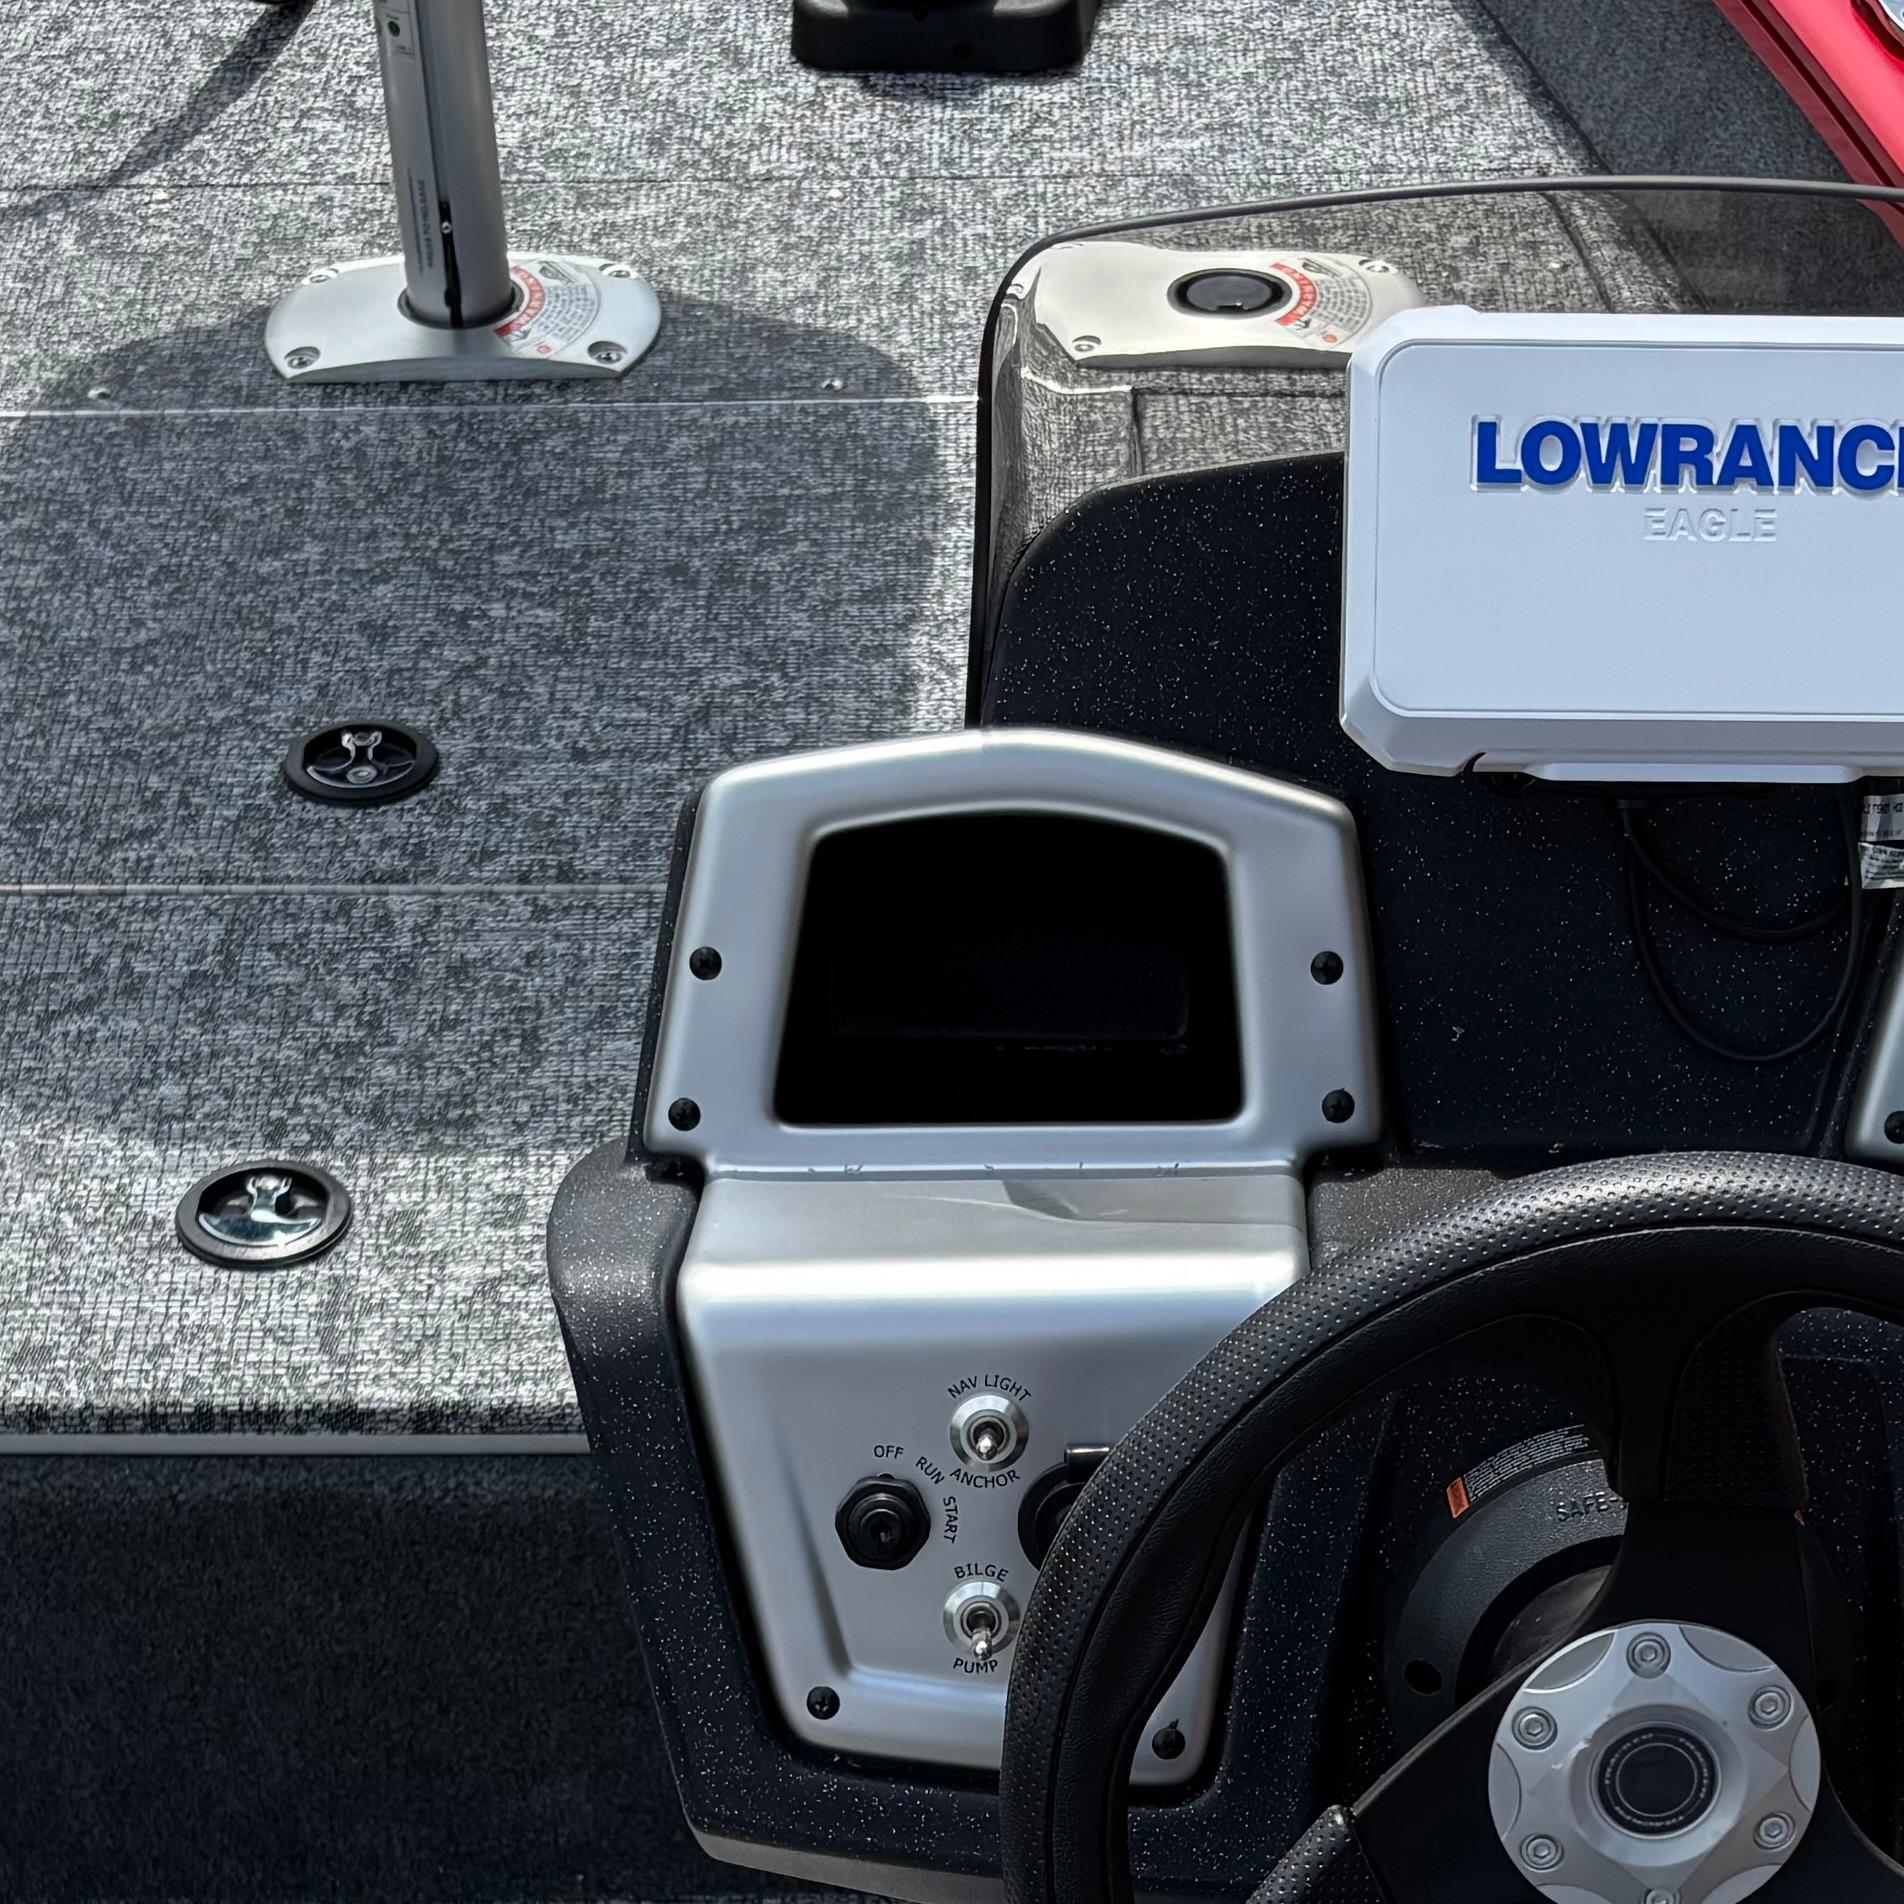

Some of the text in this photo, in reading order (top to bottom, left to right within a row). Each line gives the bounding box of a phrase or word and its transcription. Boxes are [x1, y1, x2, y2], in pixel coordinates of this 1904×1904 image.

[1643, 507, 1777, 542] EAGLE
[947, 1374, 1031, 1401] NAV LIGHT
[873, 1445, 904, 1459] OFF
[915, 1456, 945, 1485] RUN
[949, 1468, 1020, 1488] ANCHOR
[943, 1496, 959, 1544] START
[954, 1563, 1009, 1582] BILGE
[953, 1658, 998, 1674] PUMP
